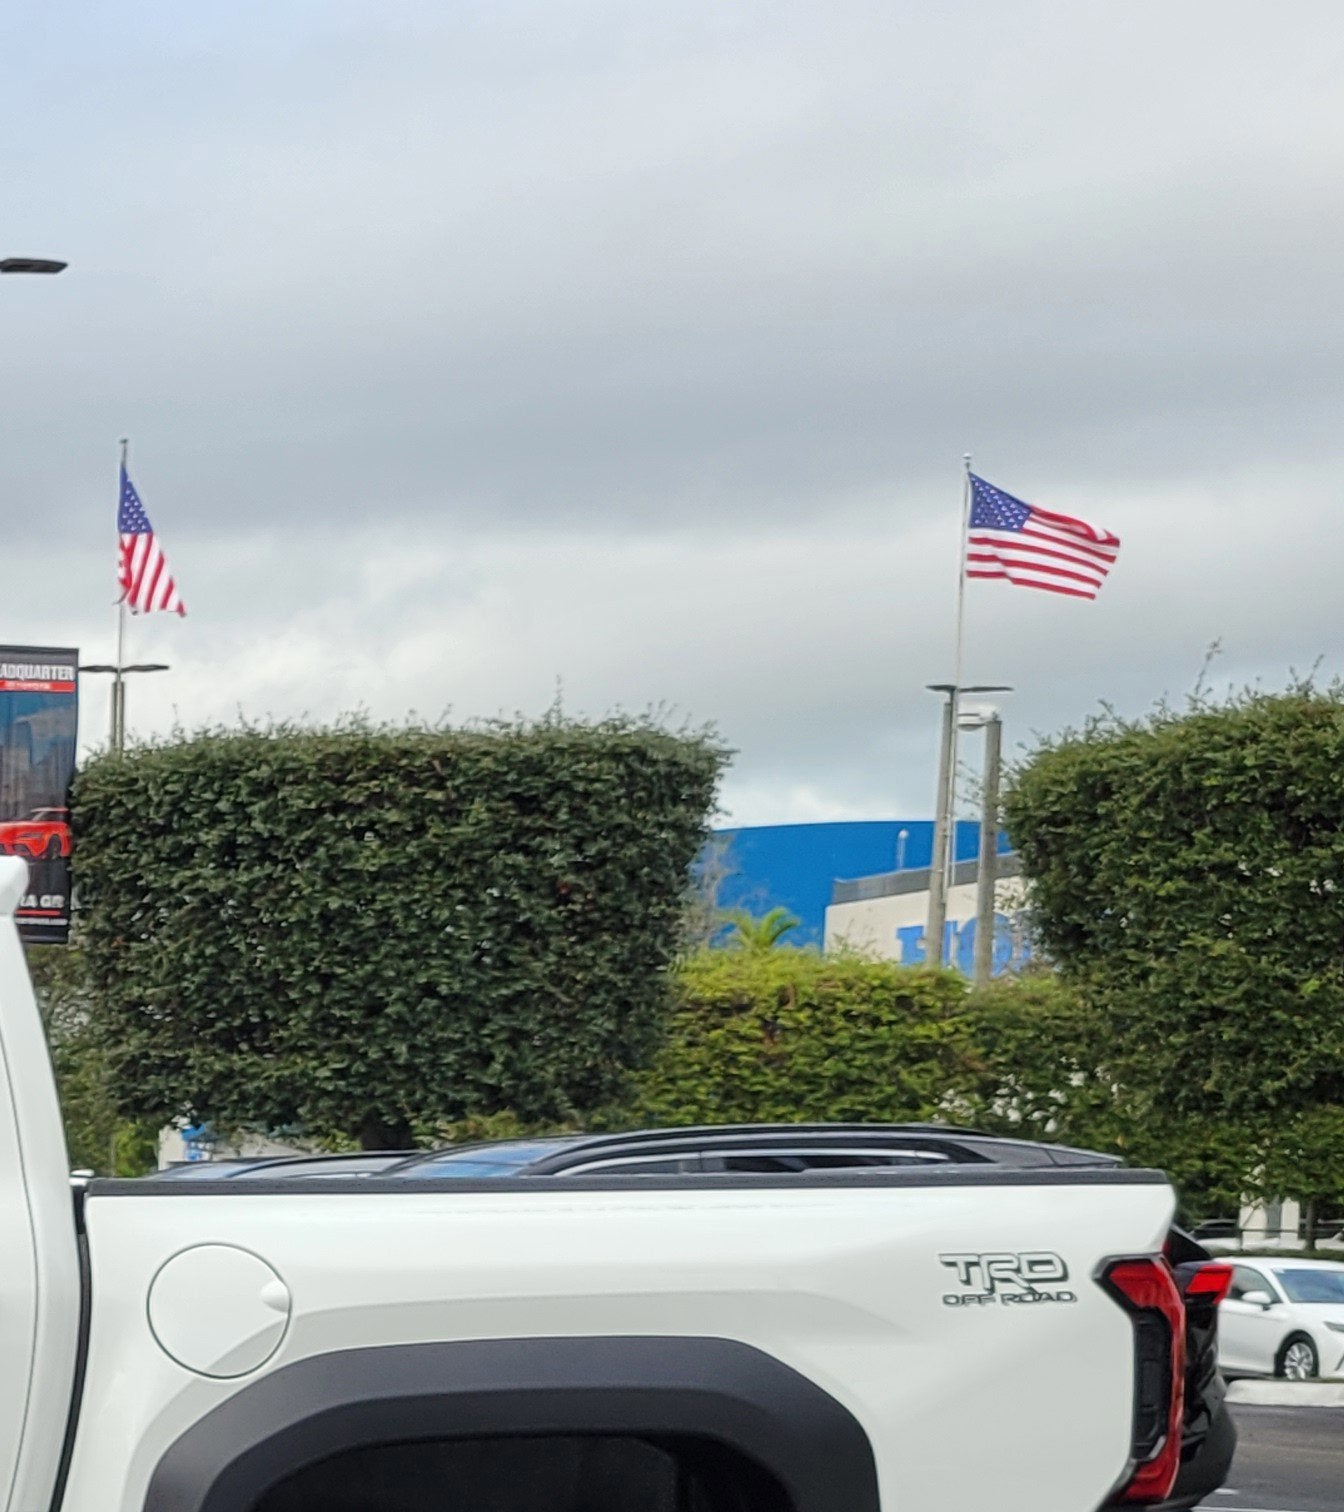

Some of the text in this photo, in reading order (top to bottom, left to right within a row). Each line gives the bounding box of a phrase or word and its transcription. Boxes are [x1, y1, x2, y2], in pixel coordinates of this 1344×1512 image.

[939, 1251, 1069, 1295] TRD
[943, 1291, 1078, 1307] OFF ROAD
